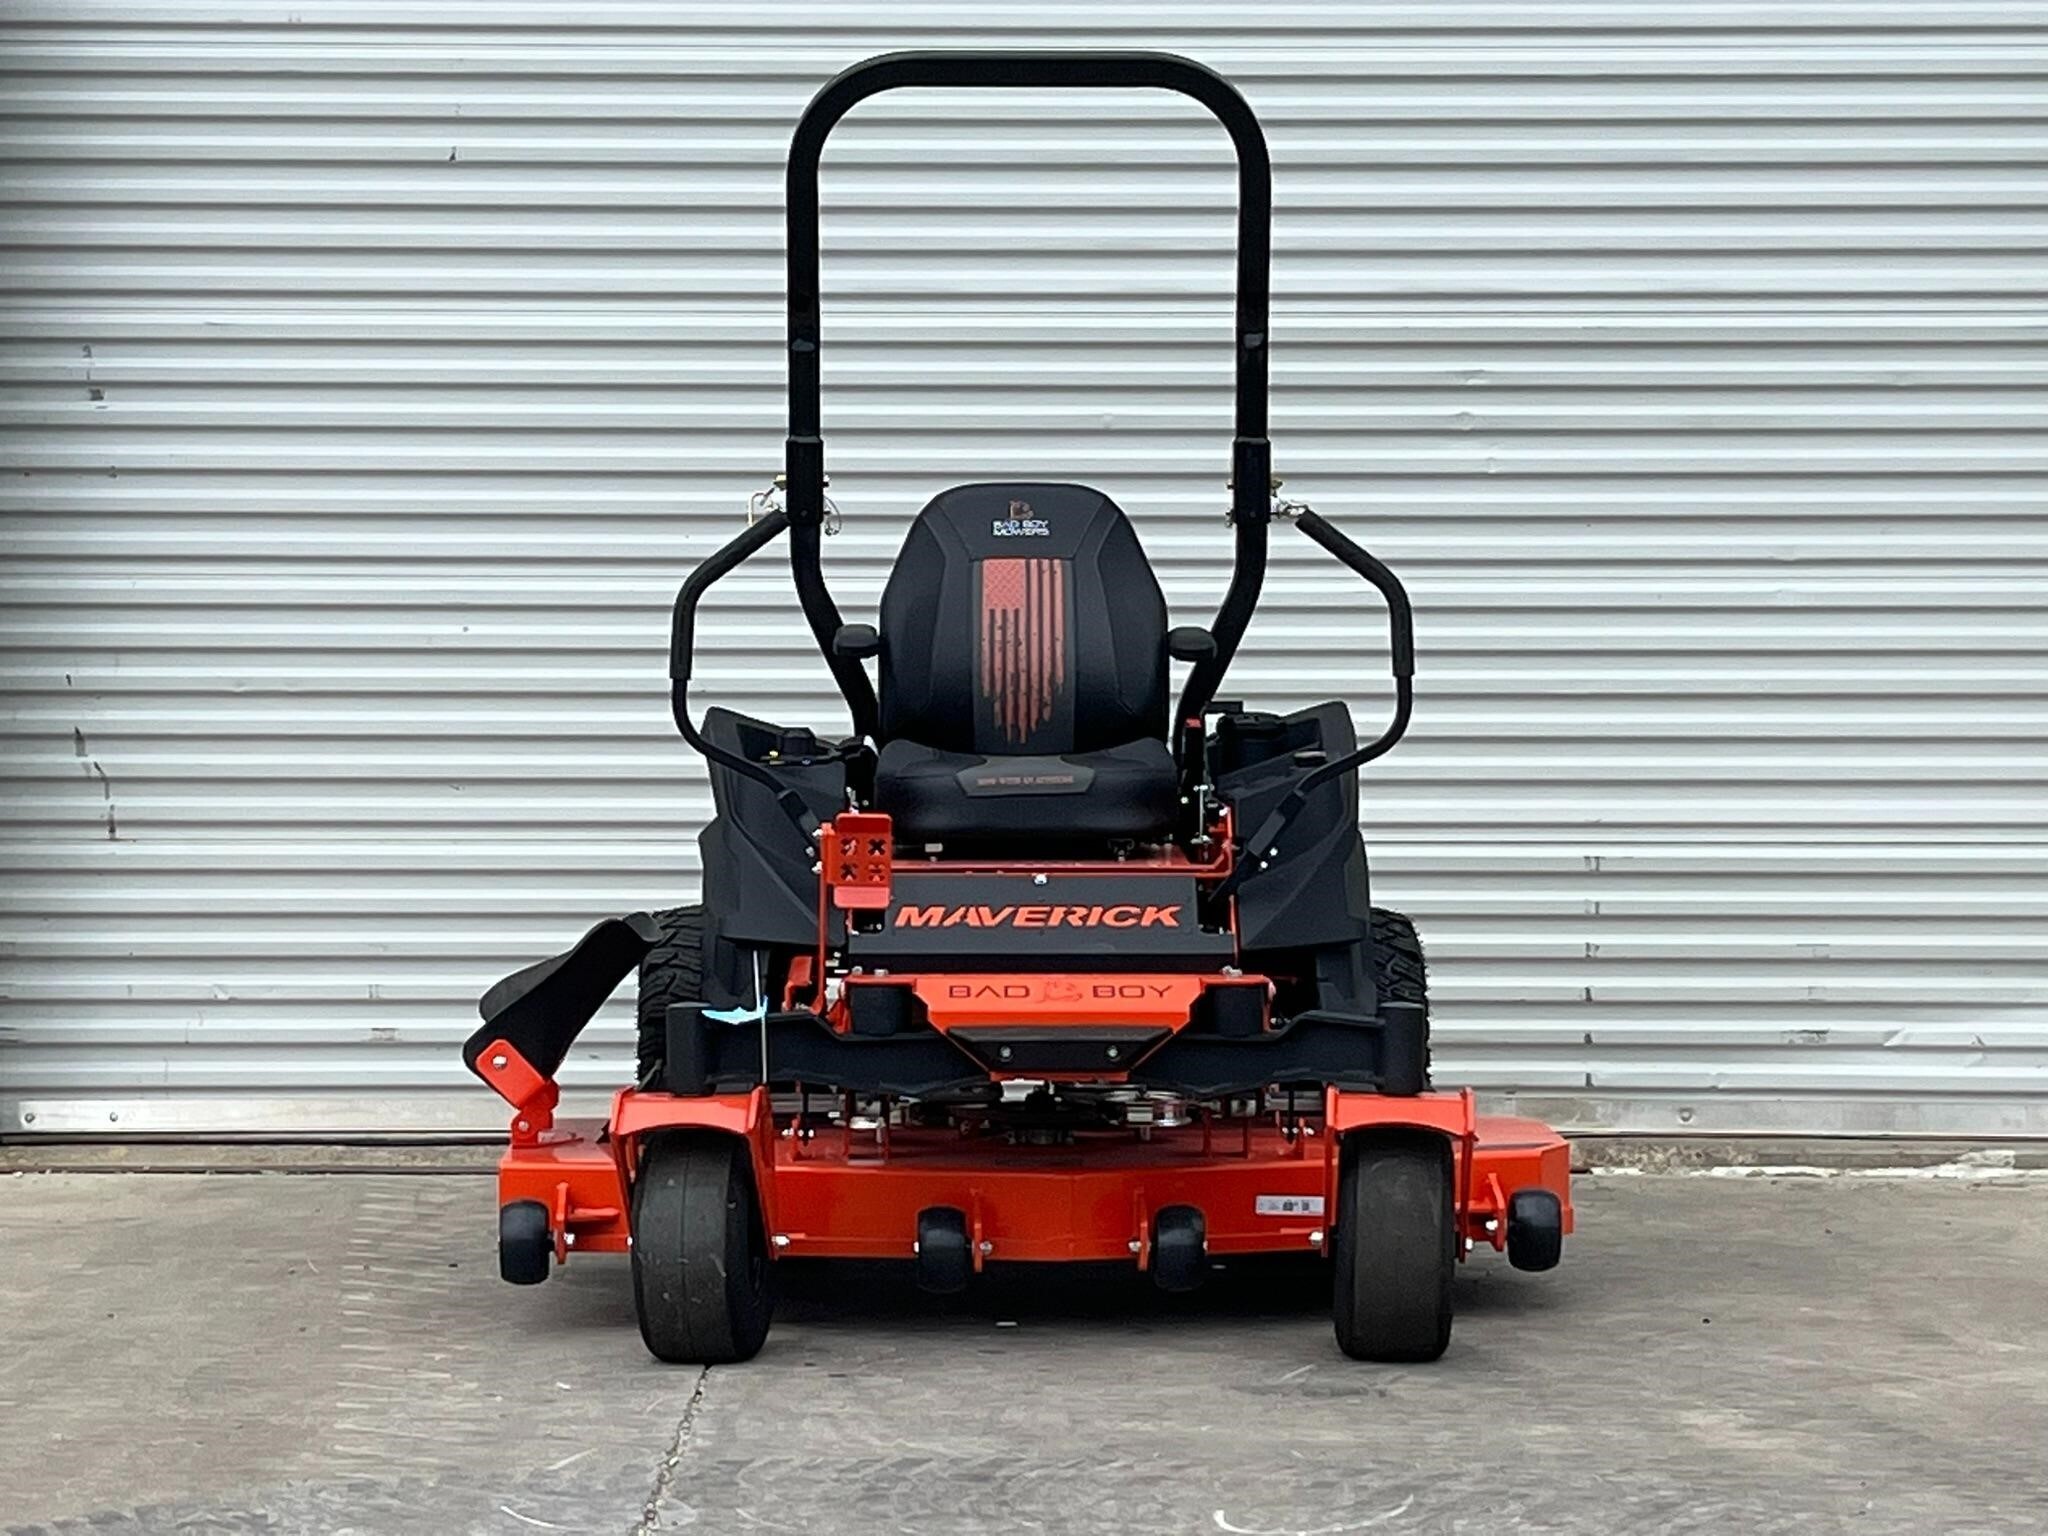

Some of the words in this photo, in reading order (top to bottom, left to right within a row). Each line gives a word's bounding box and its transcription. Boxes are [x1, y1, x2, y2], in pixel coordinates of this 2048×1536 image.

[993, 520, 1020, 529] BAD
[1022, 520, 1049, 528] BOY
[993, 528, 1050, 536] MOWERS
[894, 905, 1181, 928] MAVERICK
[949, 984, 1030, 999] BAD
[1092, 984, 1173, 999] BOY
